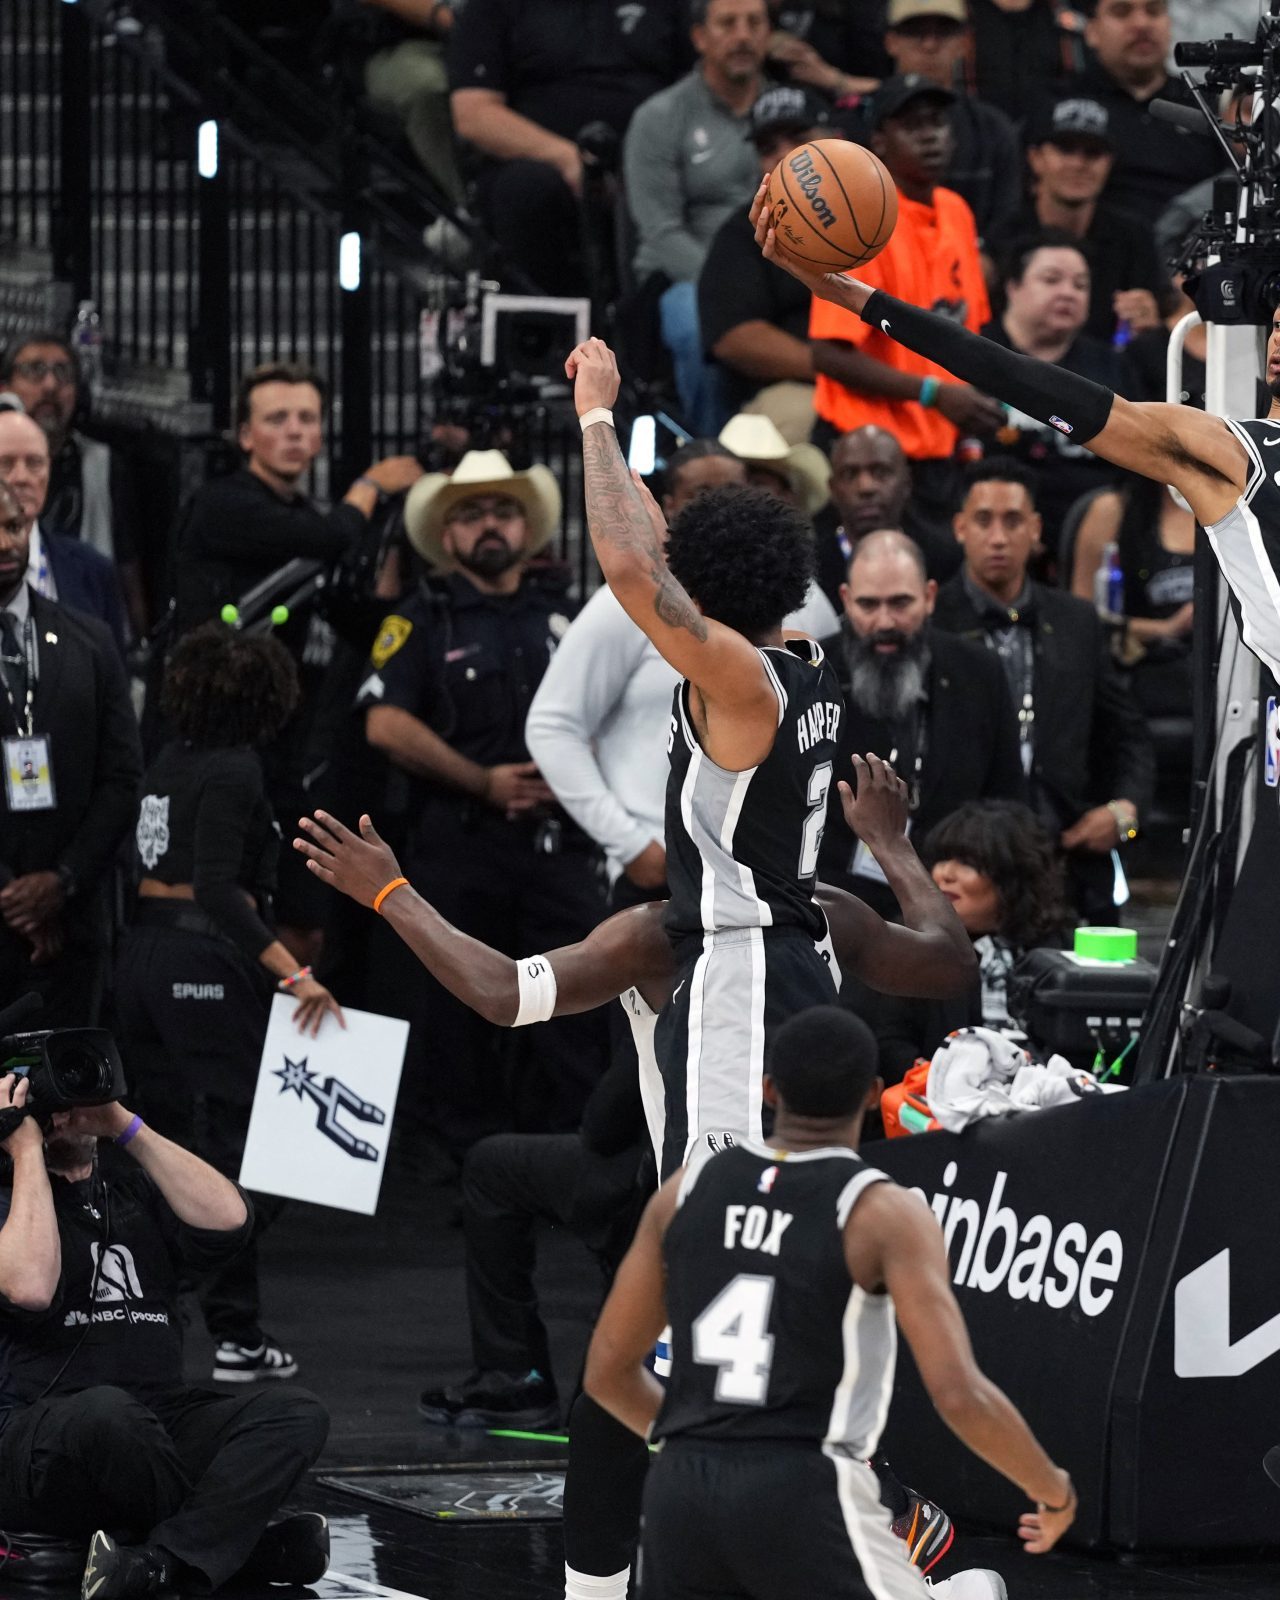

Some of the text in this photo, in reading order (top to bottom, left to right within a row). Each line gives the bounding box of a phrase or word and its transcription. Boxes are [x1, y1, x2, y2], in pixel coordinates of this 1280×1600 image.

[789, 149, 837, 230] Wilson
[798, 760, 833, 880] 2
[172, 982, 225, 1000] SPURS
[527, 962, 546, 979] 5
[724, 1204, 794, 1256] FOX
[91, 1309, 126, 1323] NBC
[691, 1272, 776, 1406] 4
